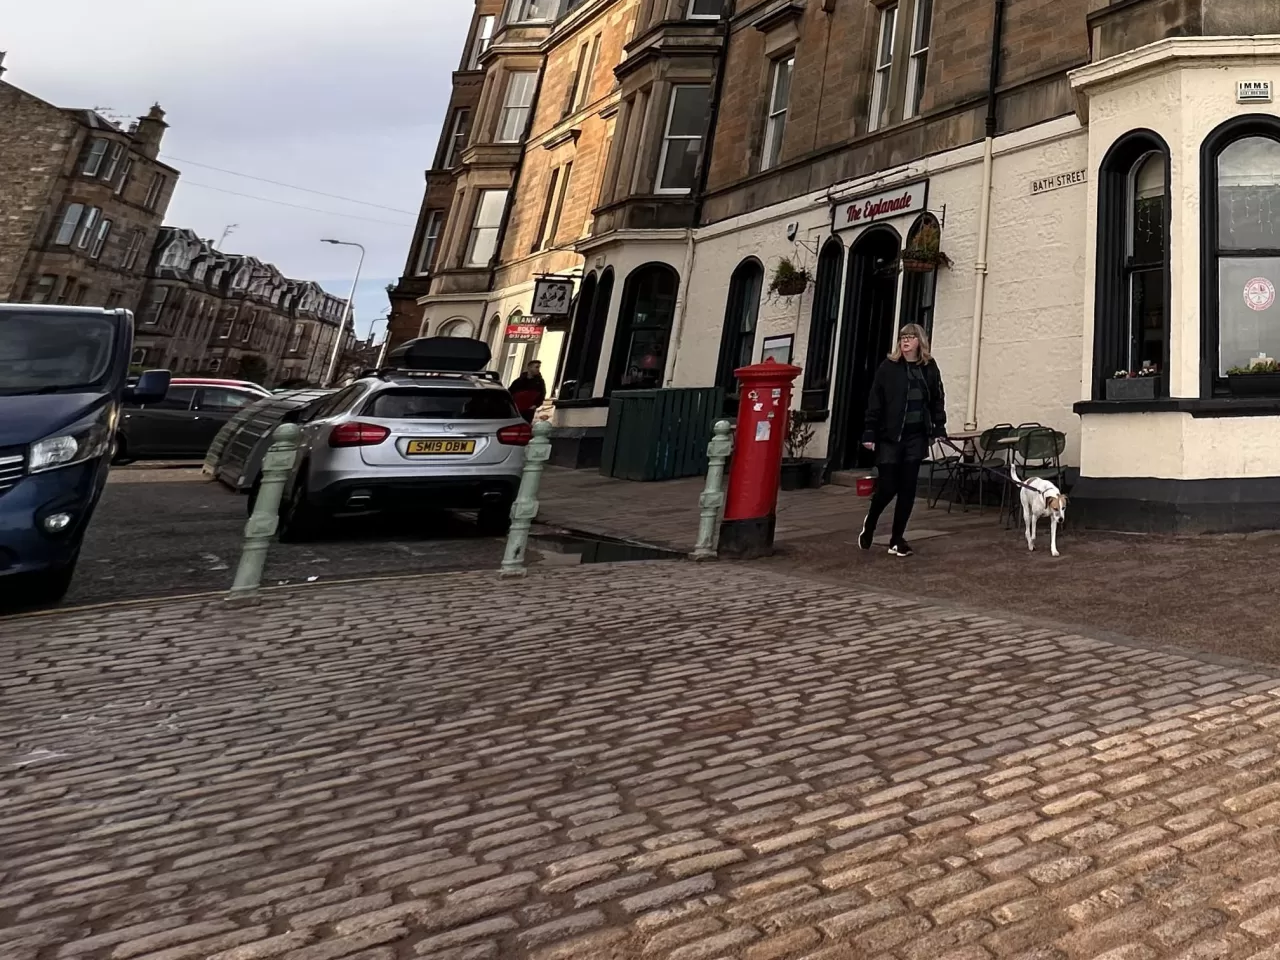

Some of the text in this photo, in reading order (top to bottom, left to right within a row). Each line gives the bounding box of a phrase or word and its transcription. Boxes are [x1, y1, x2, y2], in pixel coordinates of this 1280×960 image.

[1032, 170, 1086, 192] BATH STREET
[846, 191, 912, 223] The Esplanade
[415, 441, 468, 452] SM19 OBW
